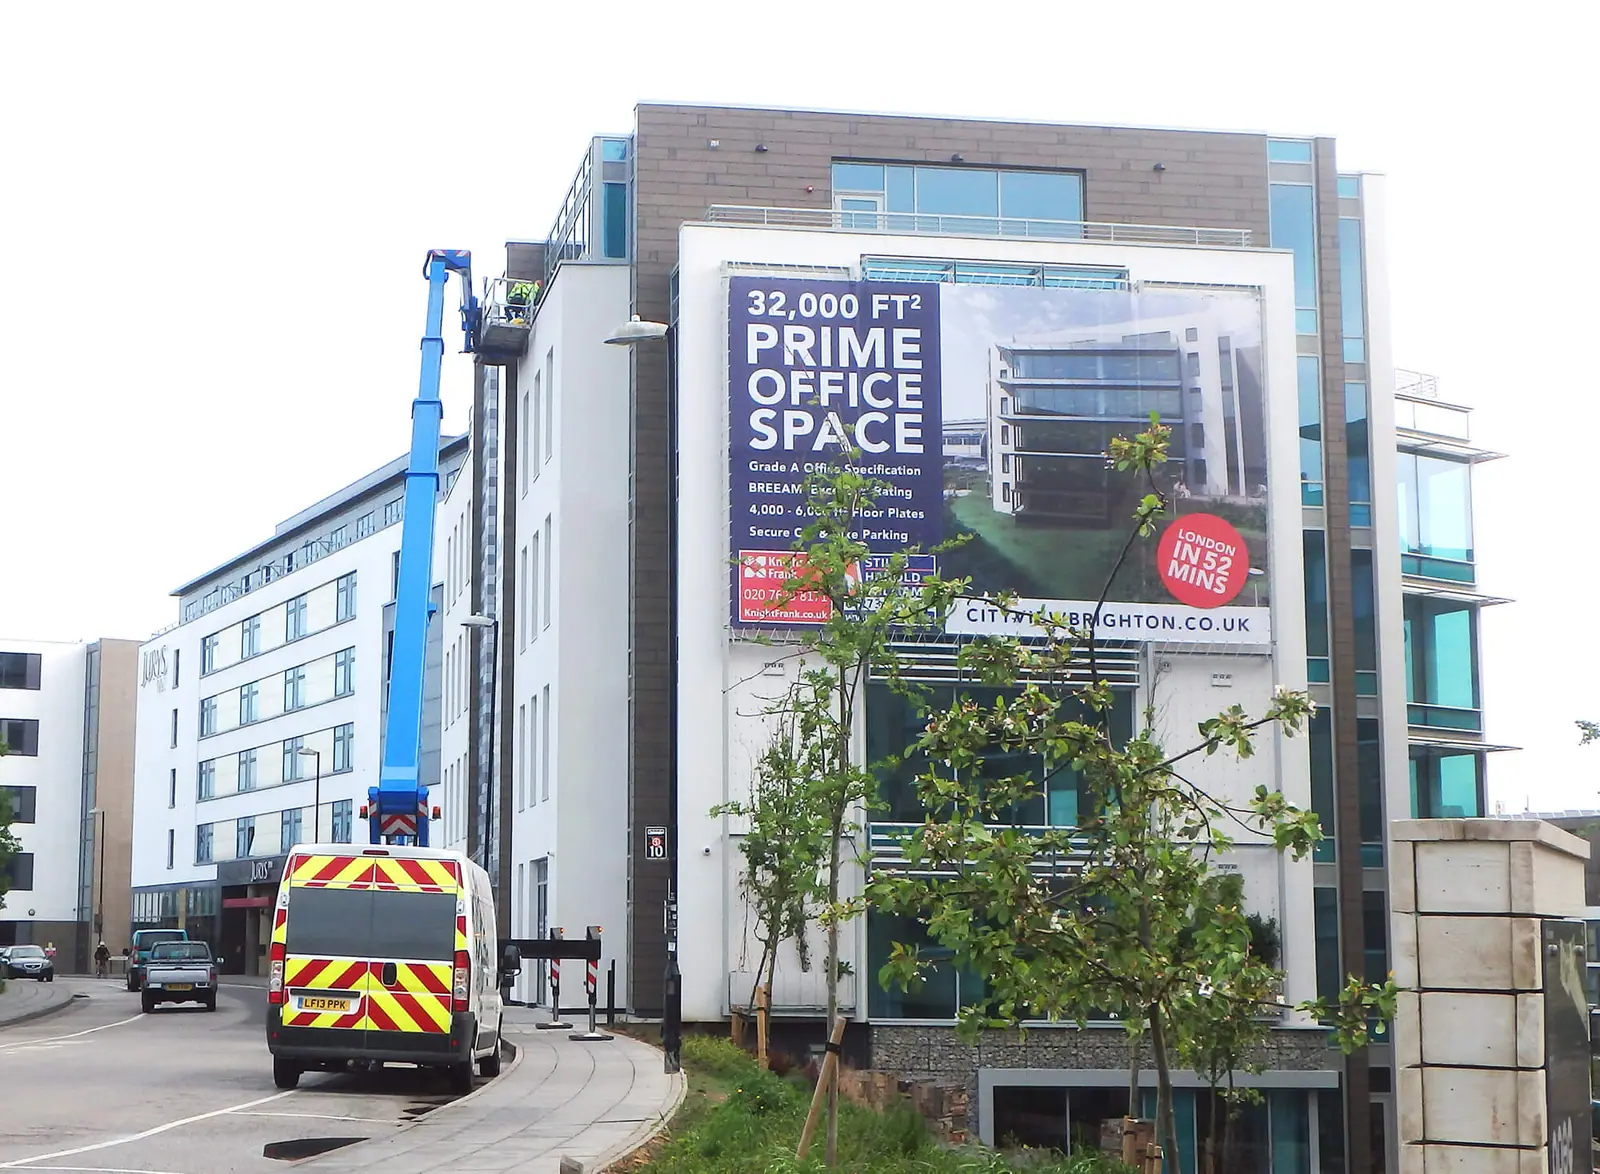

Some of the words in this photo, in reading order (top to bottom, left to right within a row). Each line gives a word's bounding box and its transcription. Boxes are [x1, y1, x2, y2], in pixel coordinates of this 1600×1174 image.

[748, 290, 859, 321] 32,000
[747, 323, 923, 369] PRIME
[748, 368, 923, 409] OFFICE
[749, 408, 924, 454] SPACE
[749, 461, 787, 472] Grade
[790, 463, 800, 473] A
[844, 464, 921, 476] Specification
[749, 482, 803, 494] BREEAM
[874, 486, 913, 500] Rating
[749, 504, 784, 516] 4,000
[795, 505, 830, 517] 6,00
[852, 507, 884, 519] Floor
[888, 508, 925, 519] Plates
[749, 526, 790, 538] Secure
[863, 530, 909, 543] Parking
[1178, 529, 1236, 556] LONDON
[1173, 540, 1202, 565] IN
[1202, 551, 1232, 576] 52
[768, 569, 800, 579] Frank
[1168, 559, 1228, 594] MINS
[744, 589, 766, 600] 020
[744, 608, 828, 619] KnightFrank.co.uk
[966, 607, 1250, 631] CITYVIBRIGHTON.CO.UK
[650, 845, 663, 857] 10
[304, 998, 325, 1008] LF13
[327, 1000, 346, 1009] PPK
